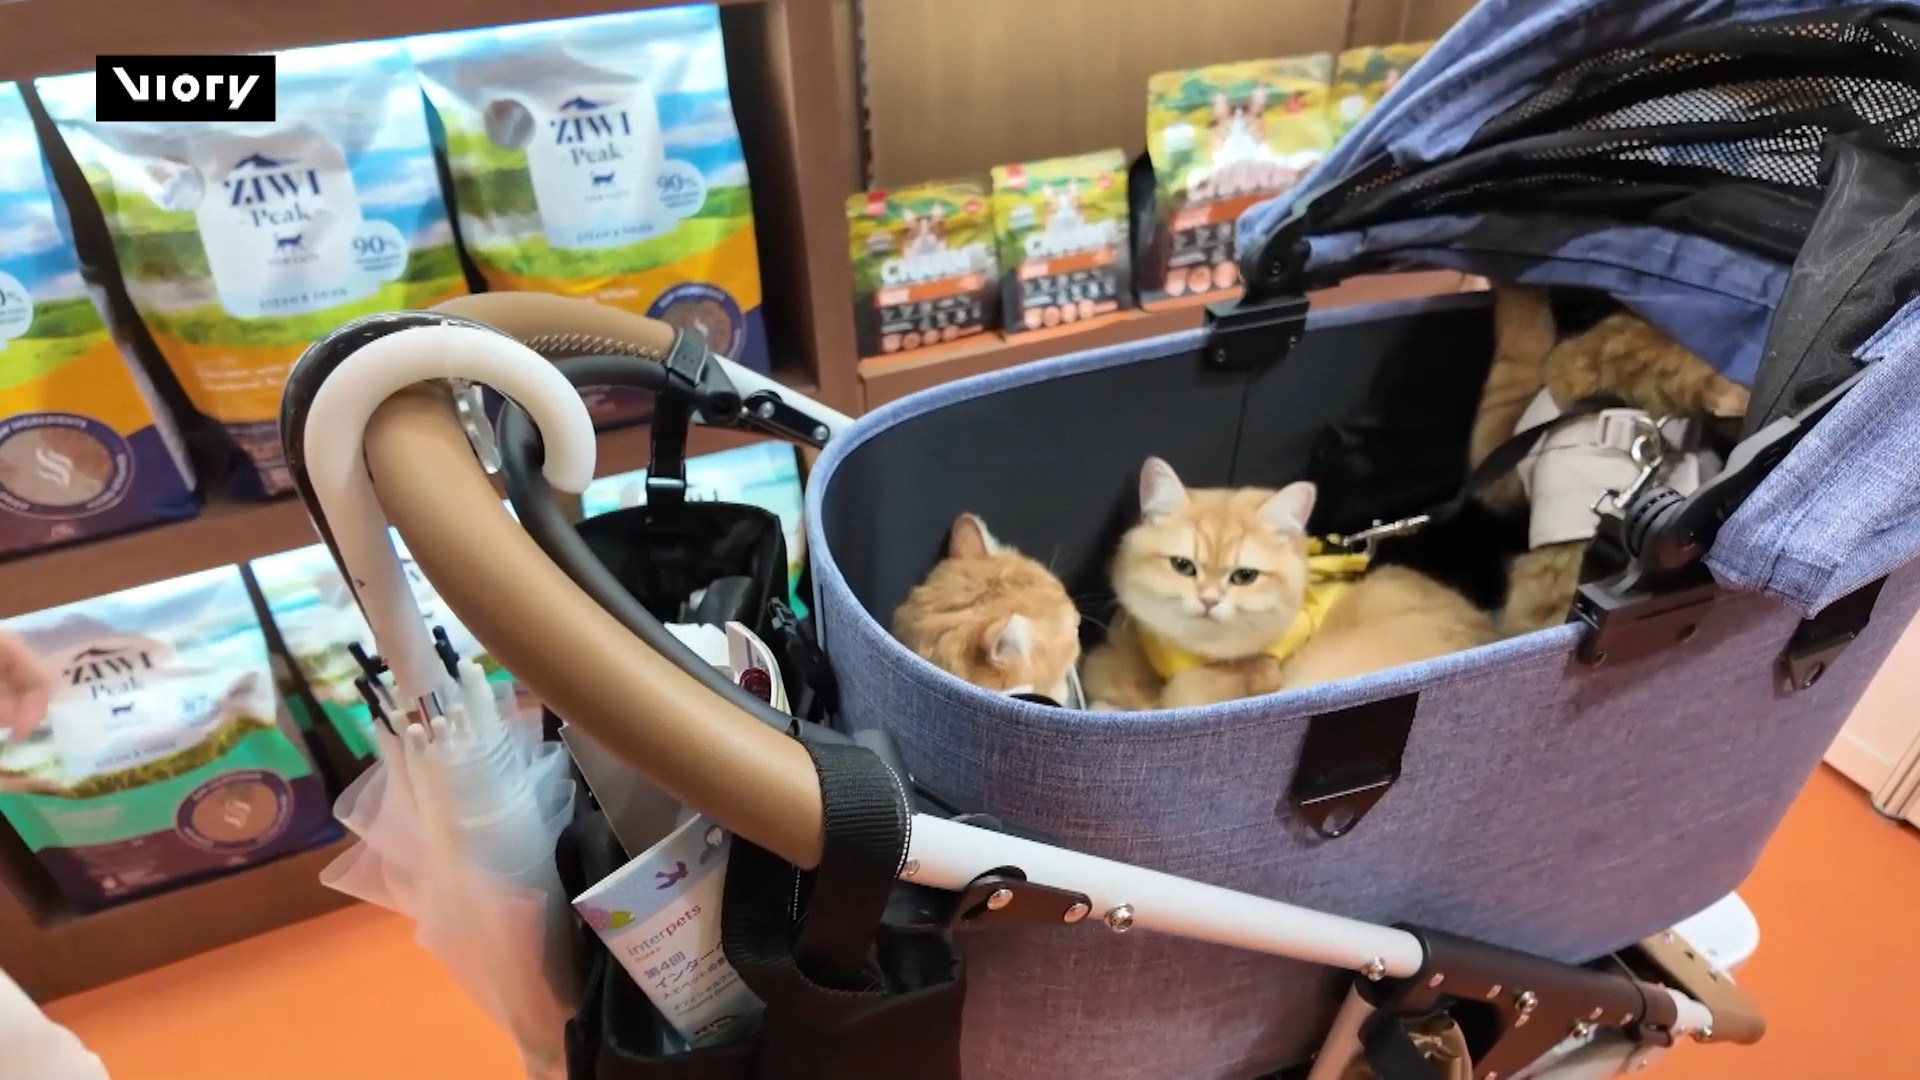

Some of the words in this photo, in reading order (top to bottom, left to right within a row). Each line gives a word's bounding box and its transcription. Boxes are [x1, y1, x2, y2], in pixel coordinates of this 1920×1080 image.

[551, 111, 630, 145] ZIWI
[571, 142, 623, 166] Peak
[223, 169, 320, 206] ZIWI
[251, 201, 313, 228] Peak
[63, 651, 153, 685] ZIWI
[626, 904, 702, 956] interpets
